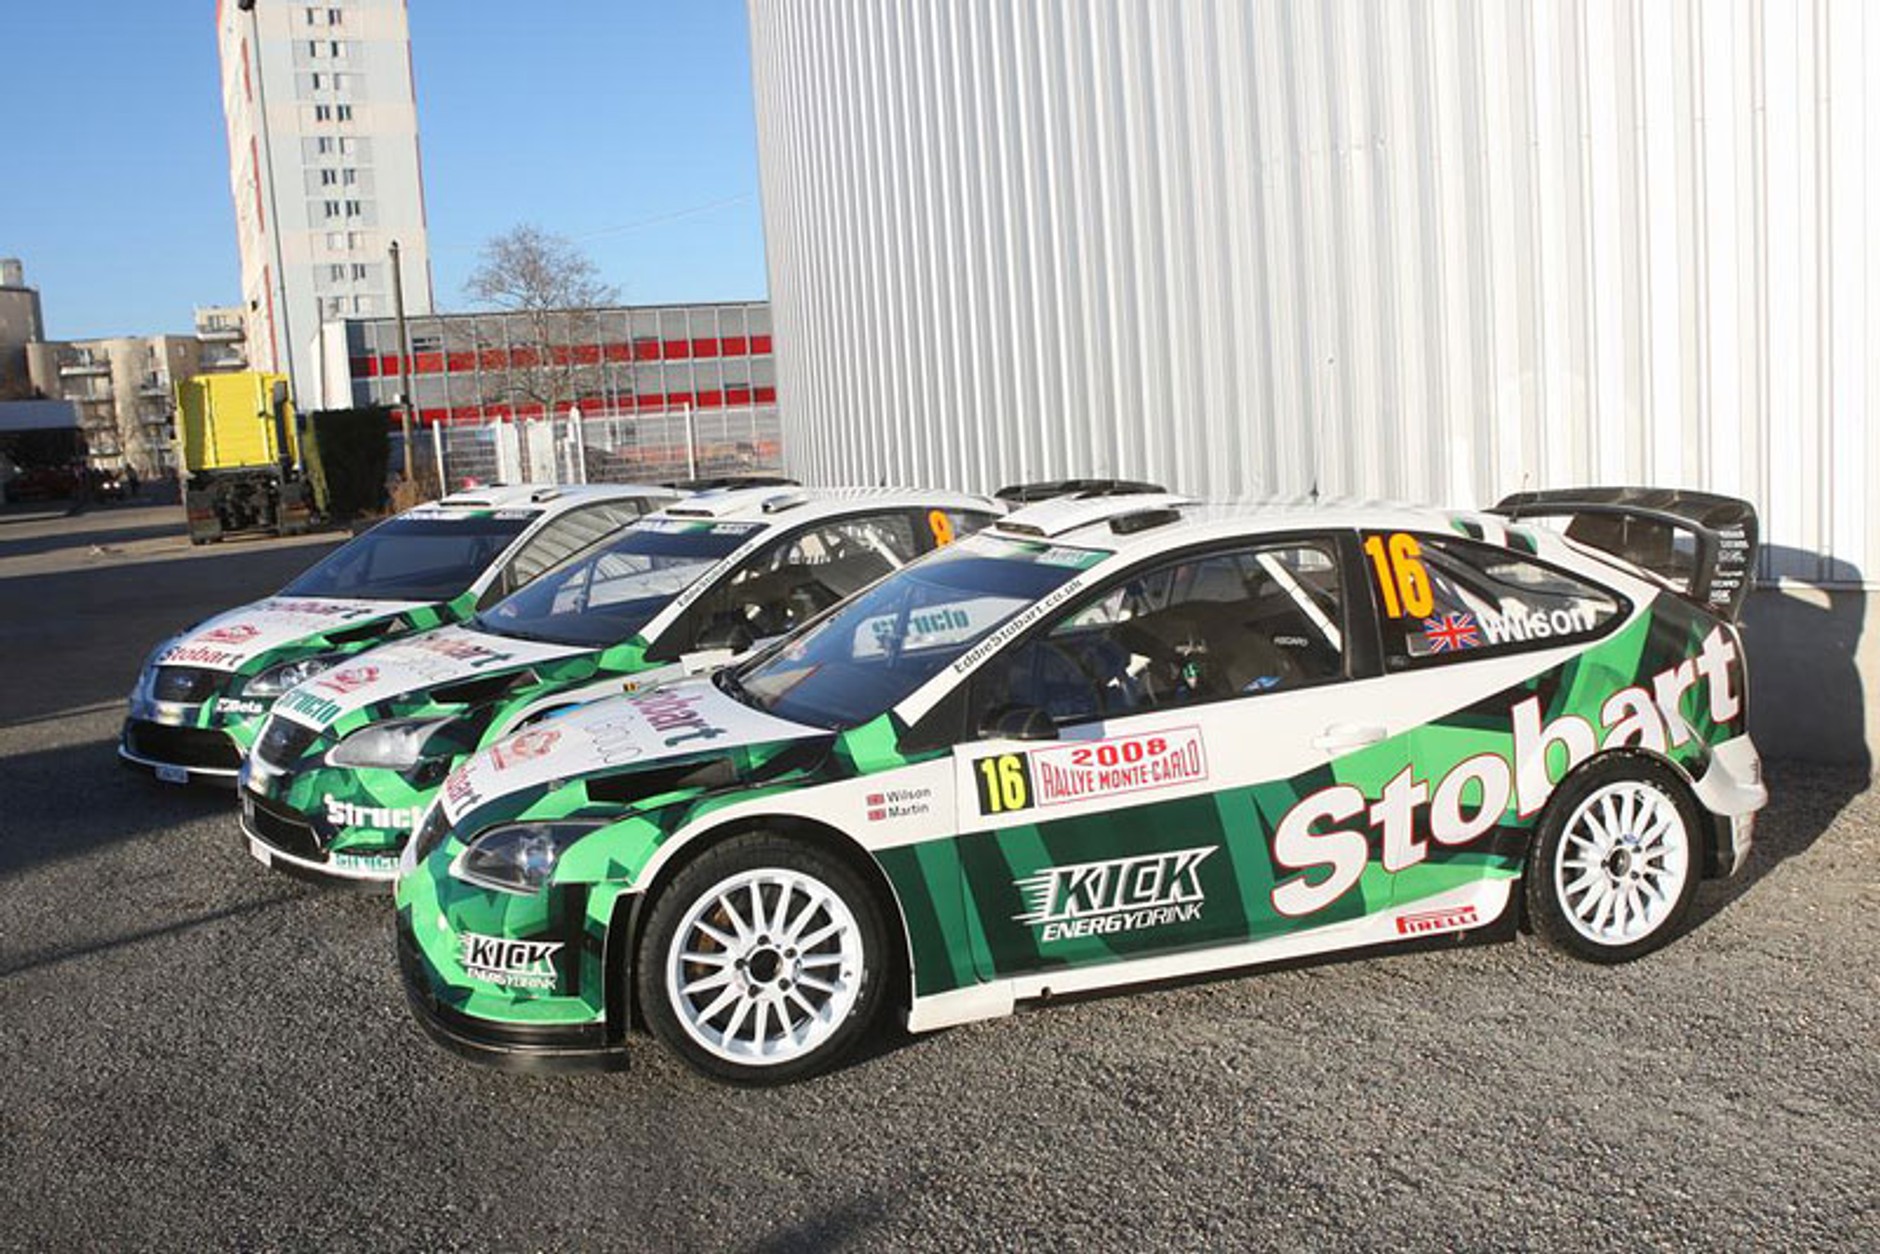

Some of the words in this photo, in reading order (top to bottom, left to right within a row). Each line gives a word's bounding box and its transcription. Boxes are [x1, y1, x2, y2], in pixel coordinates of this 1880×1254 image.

[1365, 533, 1434, 619] 16
[953, 580, 1082, 674] EddieStobart.co.uk
[1474, 604, 1599, 645] Wilson
[1071, 737, 1167, 767] 2008
[1271, 624, 1742, 918] Stobart
[886, 788, 931, 803] Wilson
[980, 754, 1027, 814] 16
[1040, 761, 1094, 800] RALLYE
[888, 803, 930, 819] Martin
[1041, 846, 1219, 921] KICK
[1395, 906, 1478, 935] PIRELLI
[462, 931, 565, 976] KICK
